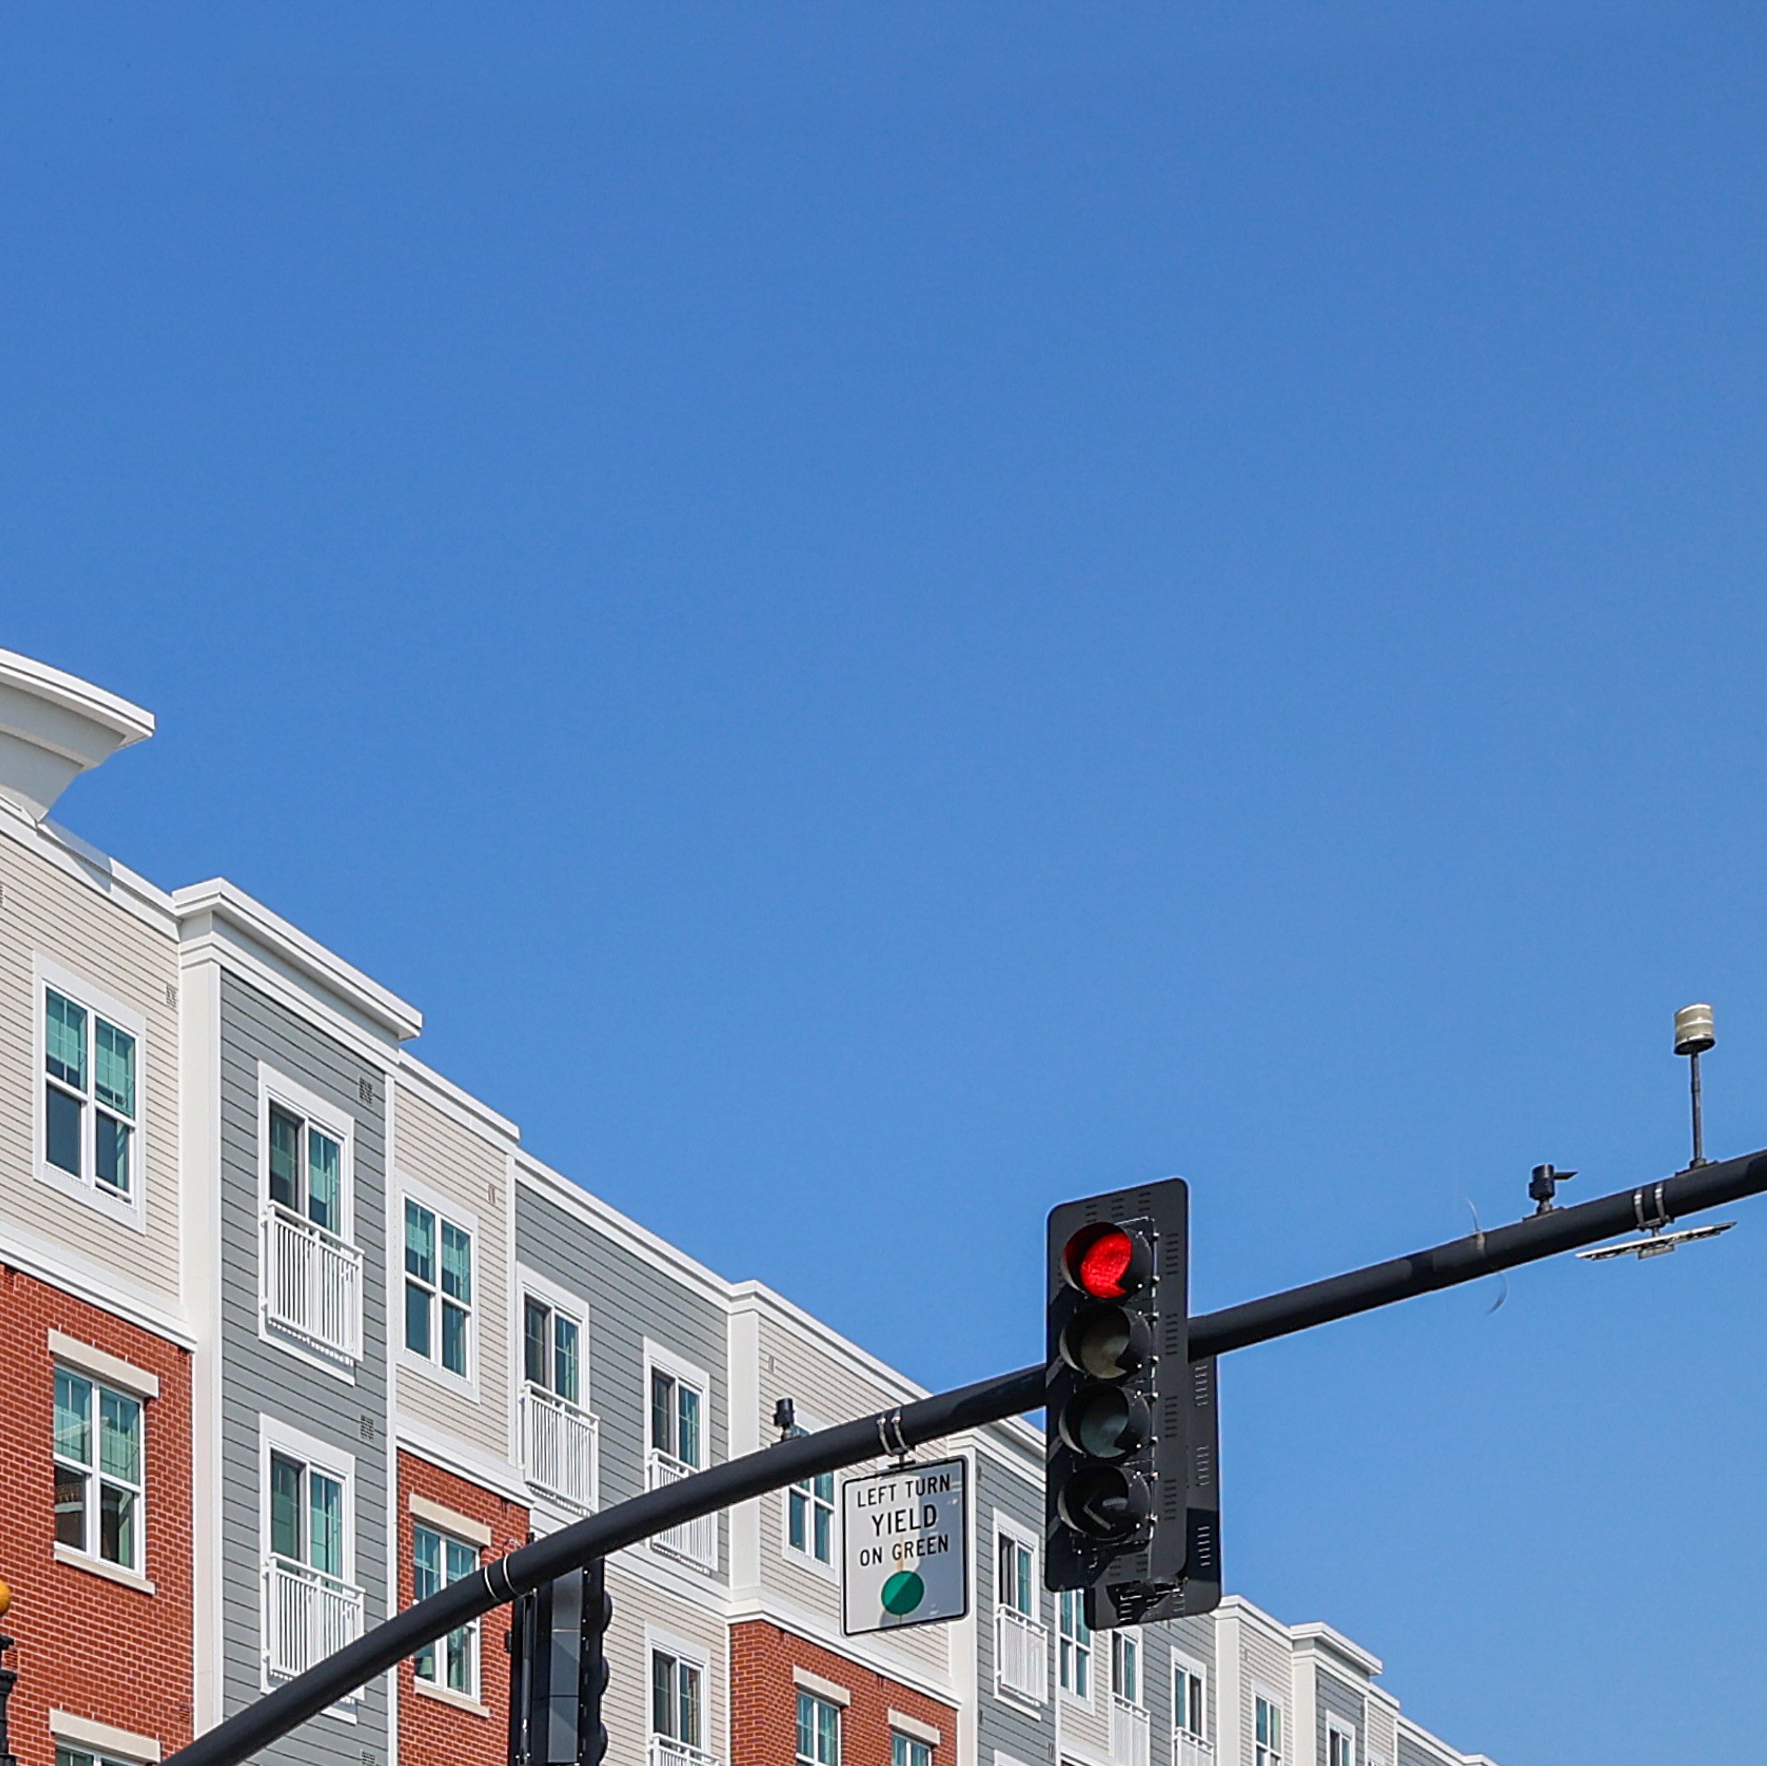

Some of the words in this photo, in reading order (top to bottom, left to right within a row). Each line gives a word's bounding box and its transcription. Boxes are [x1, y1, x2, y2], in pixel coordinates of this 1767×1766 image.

[857, 1484, 897, 1508] LEFT
[905, 1473, 950, 1499] TURN
[871, 1504, 938, 1537] YIELD
[860, 1547, 883, 1567] ON
[892, 1534, 949, 1560] GREEN
